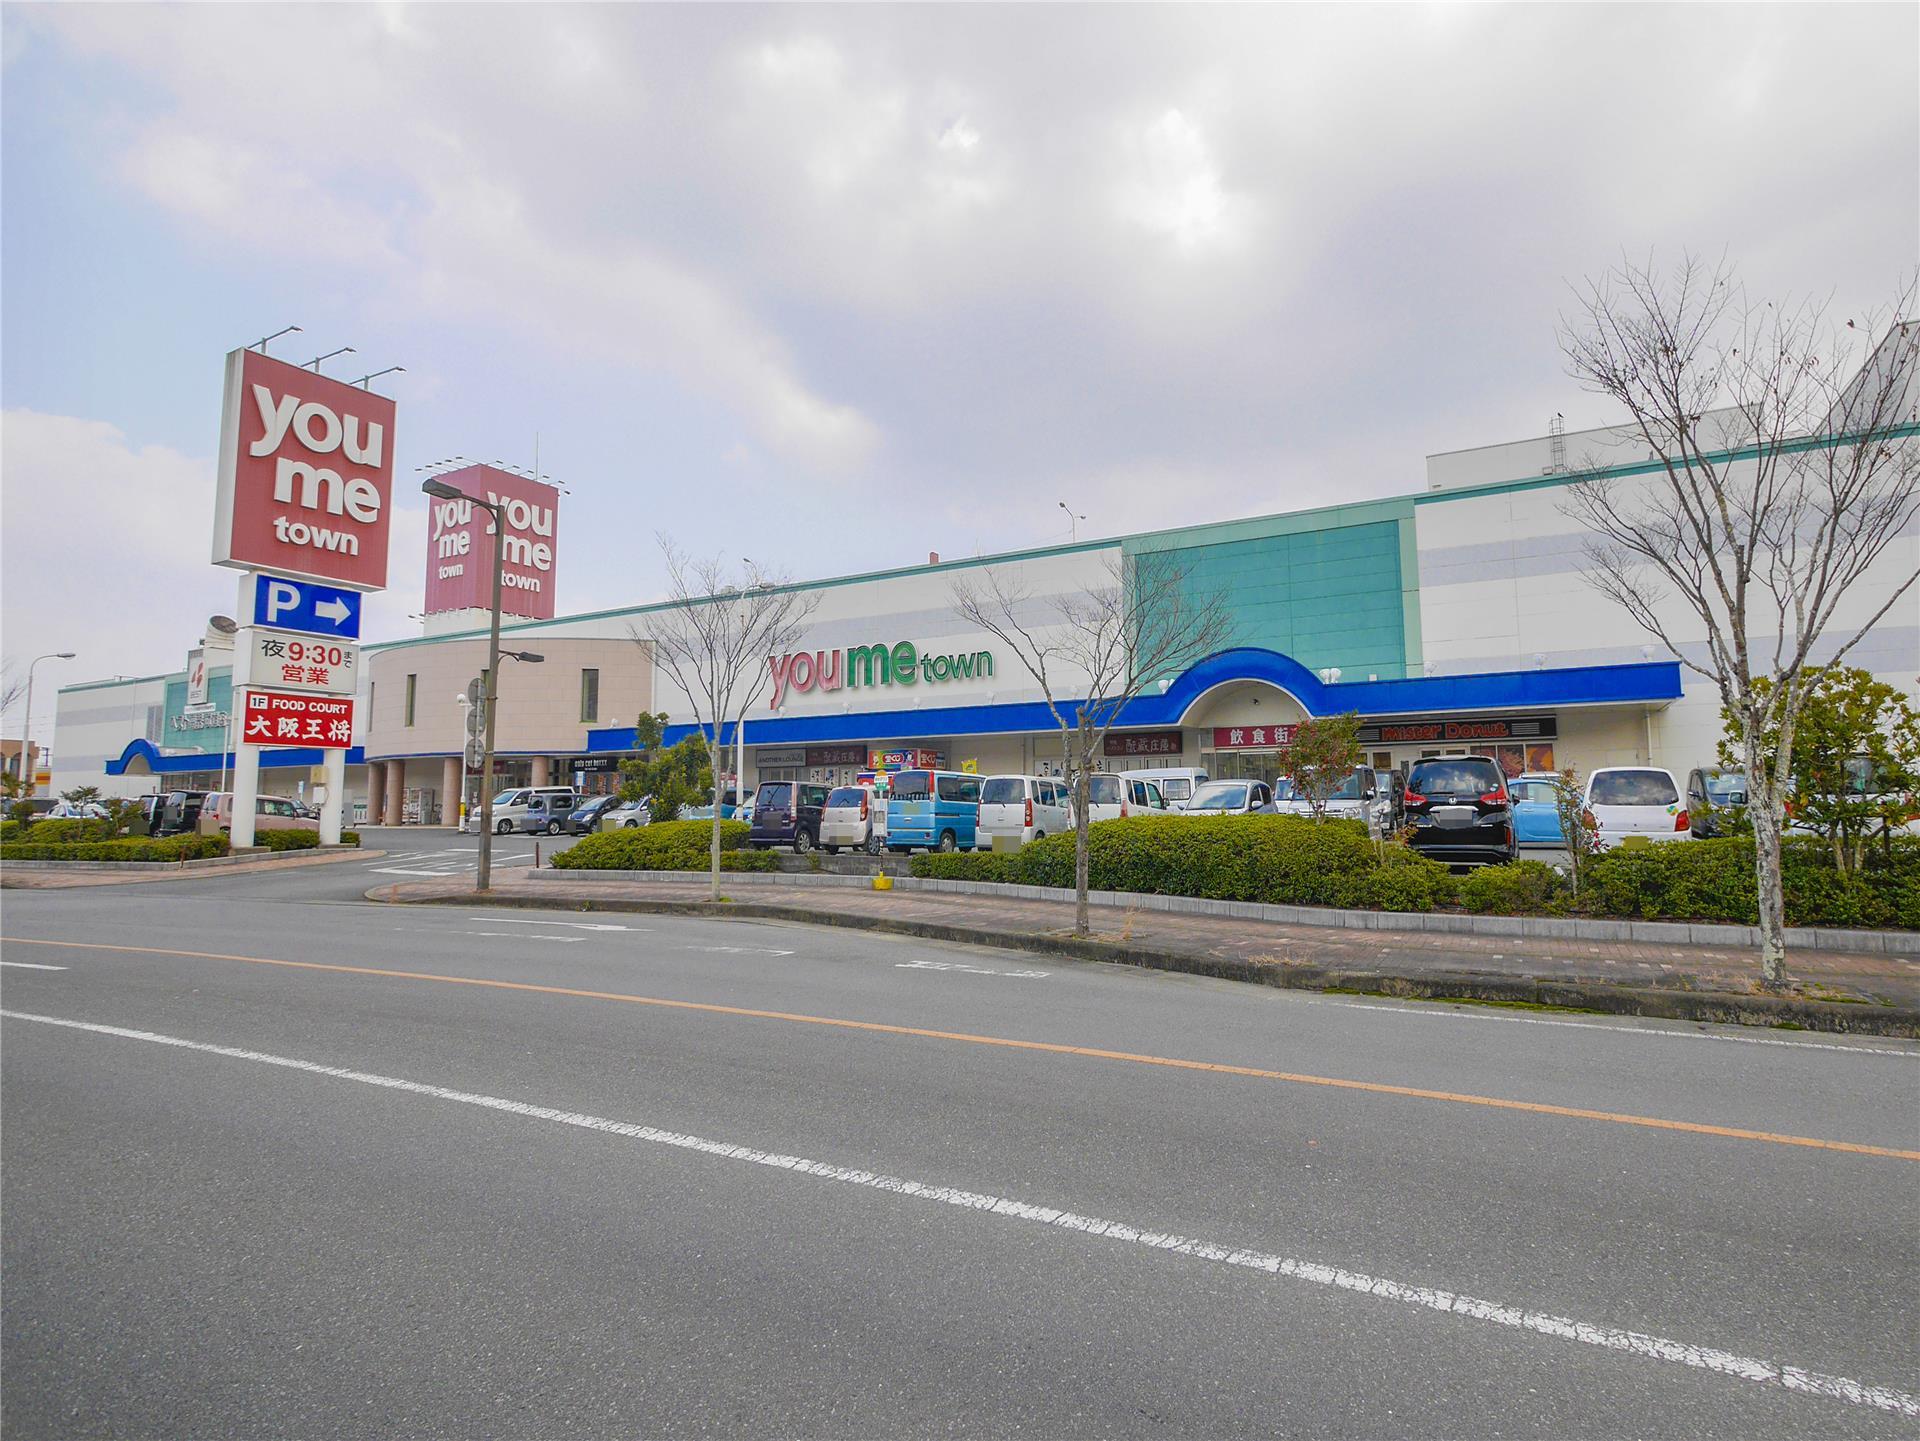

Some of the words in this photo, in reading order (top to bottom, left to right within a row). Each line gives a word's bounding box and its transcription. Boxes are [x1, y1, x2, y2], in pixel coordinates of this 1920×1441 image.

[249, 383, 383, 468] you
[273, 456, 381, 523] me
[433, 500, 472, 541] you
[486, 491, 553, 537] you
[273, 515, 360, 556] town
[439, 530, 471, 559] me
[503, 534, 552, 571] me
[438, 563, 464, 580] town
[501, 569, 541, 593] town
[267, 581, 301, 622] P
[281, 664, 330, 685] 営業
[252, 697, 266, 710] 1F
[272, 699, 306, 711] FOOD
[309, 702, 348, 714] COURT
[246, 715, 351, 742] 大阪王将
[1230, 727, 1289, 745] 飲食街
[1445, 722, 1509, 739] Donut
